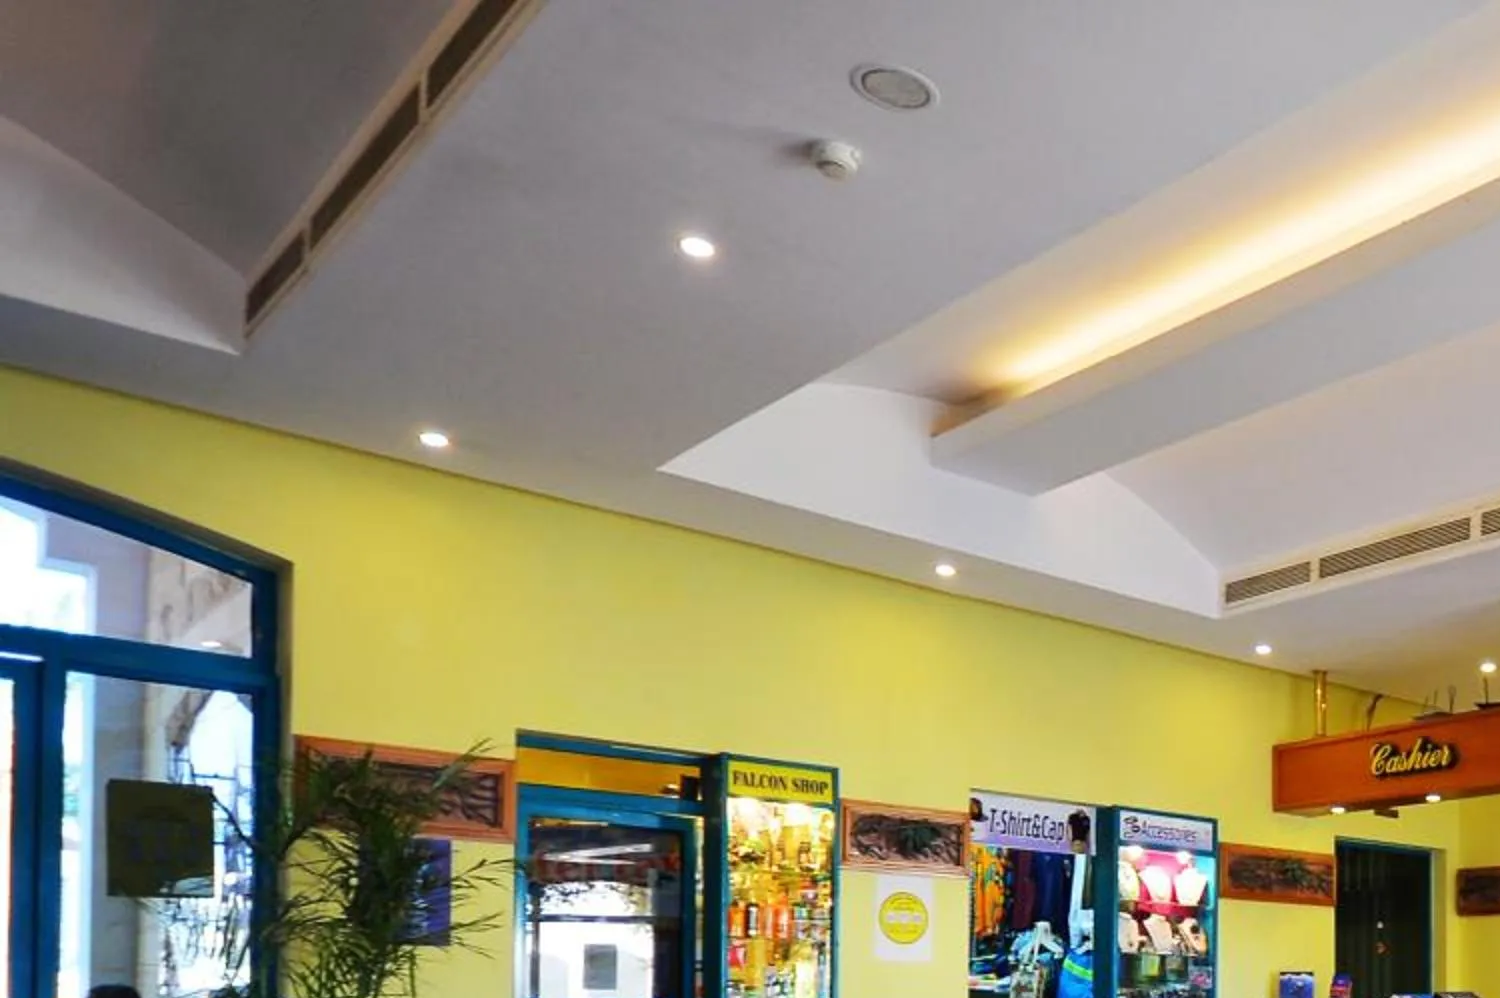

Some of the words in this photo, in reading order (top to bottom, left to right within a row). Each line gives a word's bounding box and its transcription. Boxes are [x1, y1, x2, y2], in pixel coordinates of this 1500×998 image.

[1368, 735, 1453, 777] Cashier
[732, 768, 788, 792] FALCON
[791, 777, 829, 796] SHOP
